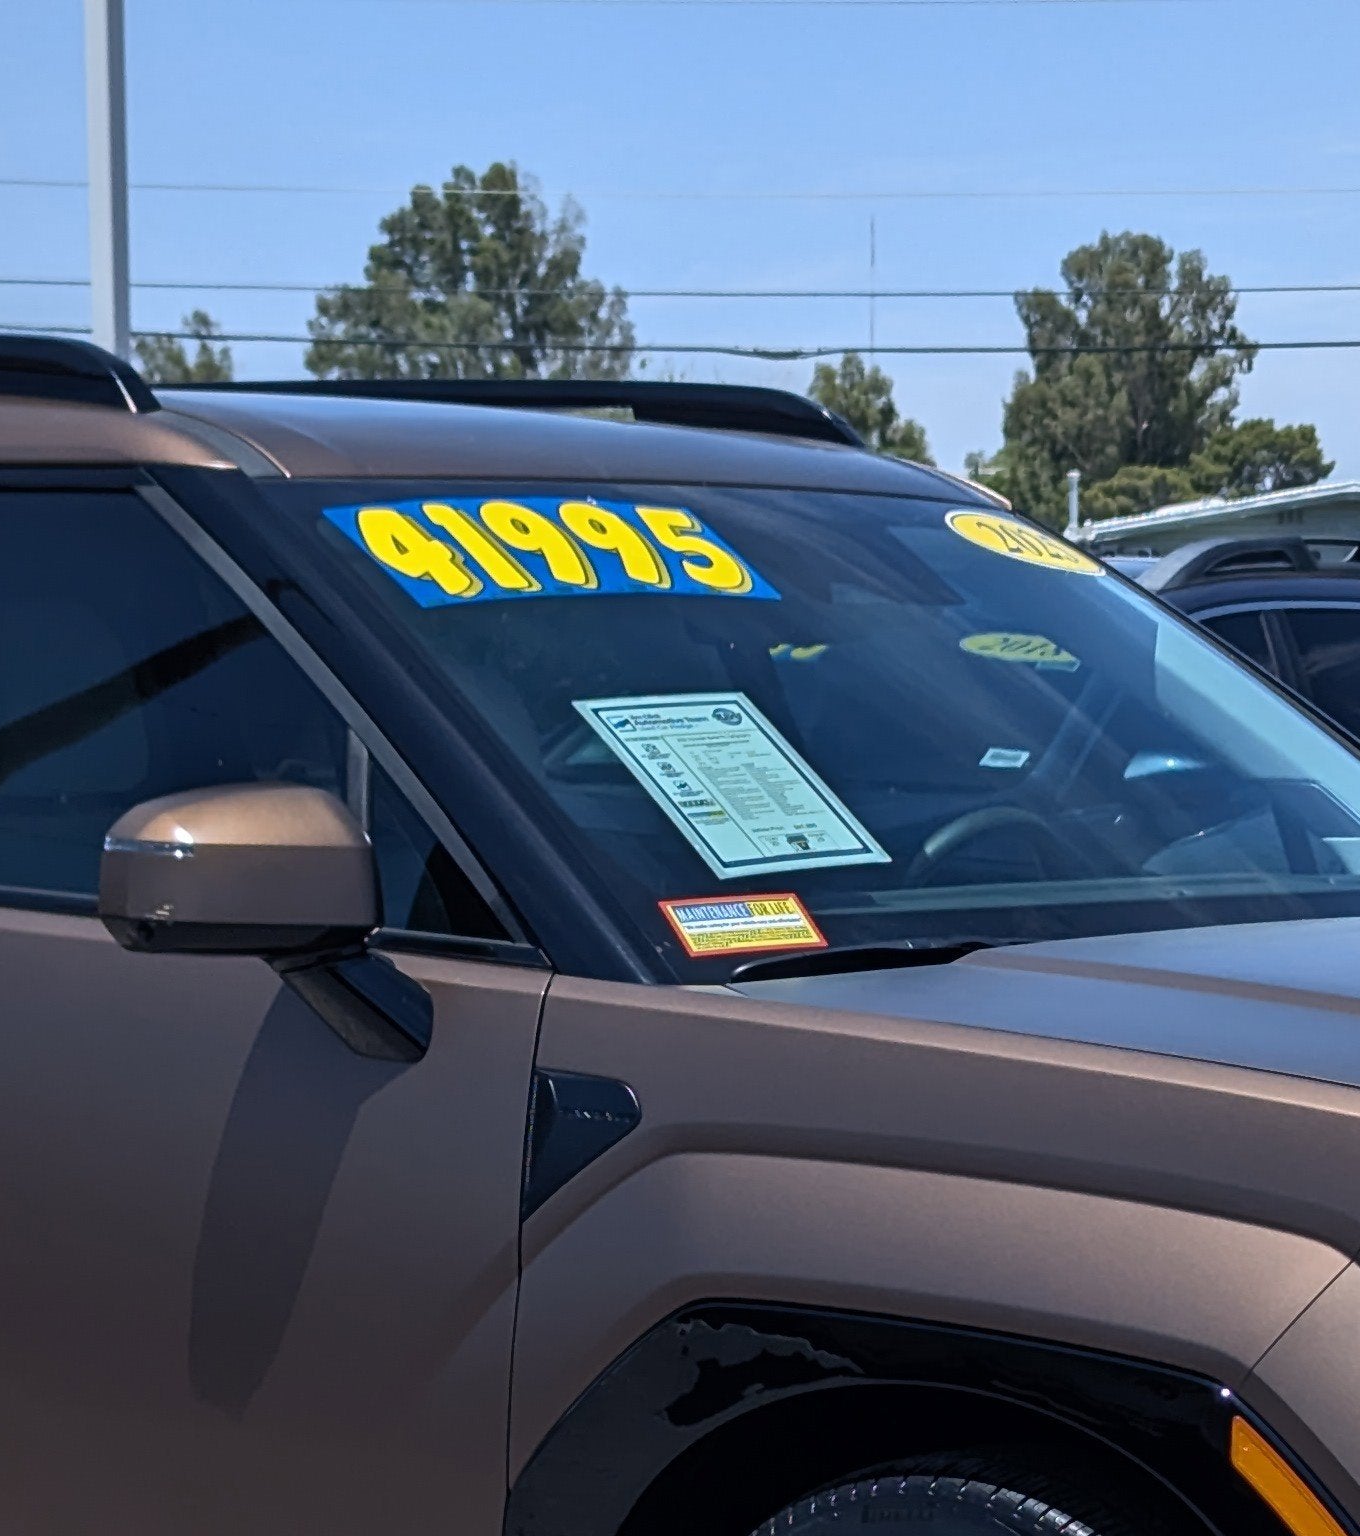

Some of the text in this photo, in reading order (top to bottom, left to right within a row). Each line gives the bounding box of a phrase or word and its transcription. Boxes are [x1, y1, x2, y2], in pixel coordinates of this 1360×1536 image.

[356, 501, 753, 598] 41995
[675, 903, 748, 923] MAINTENANCE
[748, 901, 769, 916] FOR
